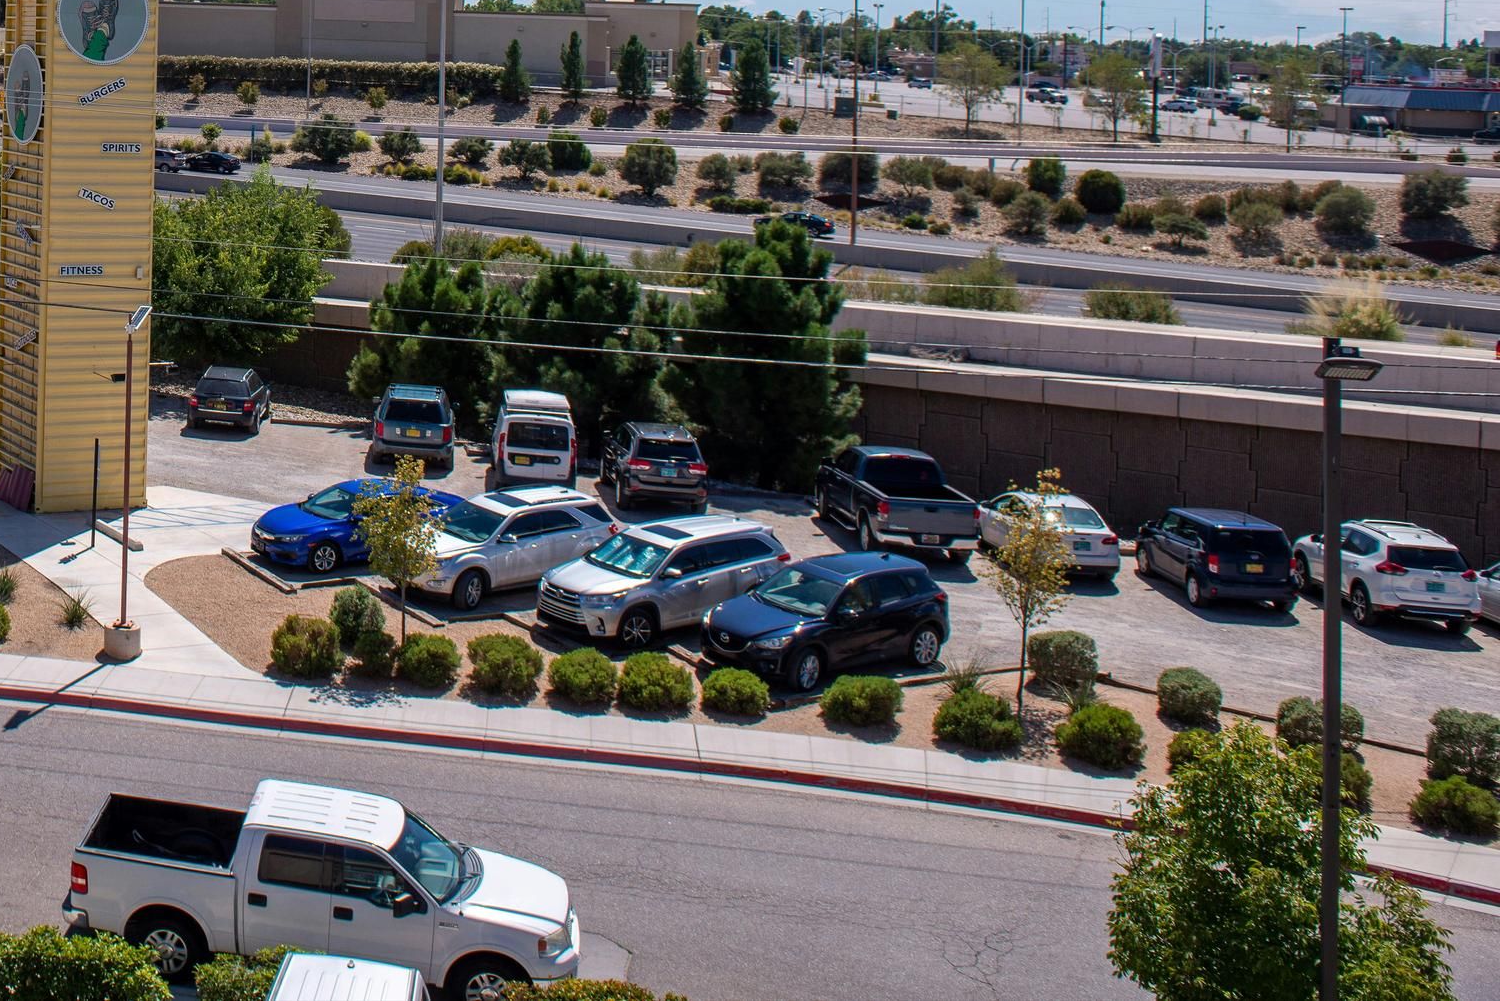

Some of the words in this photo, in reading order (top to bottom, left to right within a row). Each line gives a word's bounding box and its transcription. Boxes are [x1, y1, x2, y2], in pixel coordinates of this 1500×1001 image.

[79, 78, 126, 106] BURGERS
[102, 143, 141, 153] SPIRITS
[81, 188, 115, 209] TACOS
[60, 266, 103, 275] FITNESS
